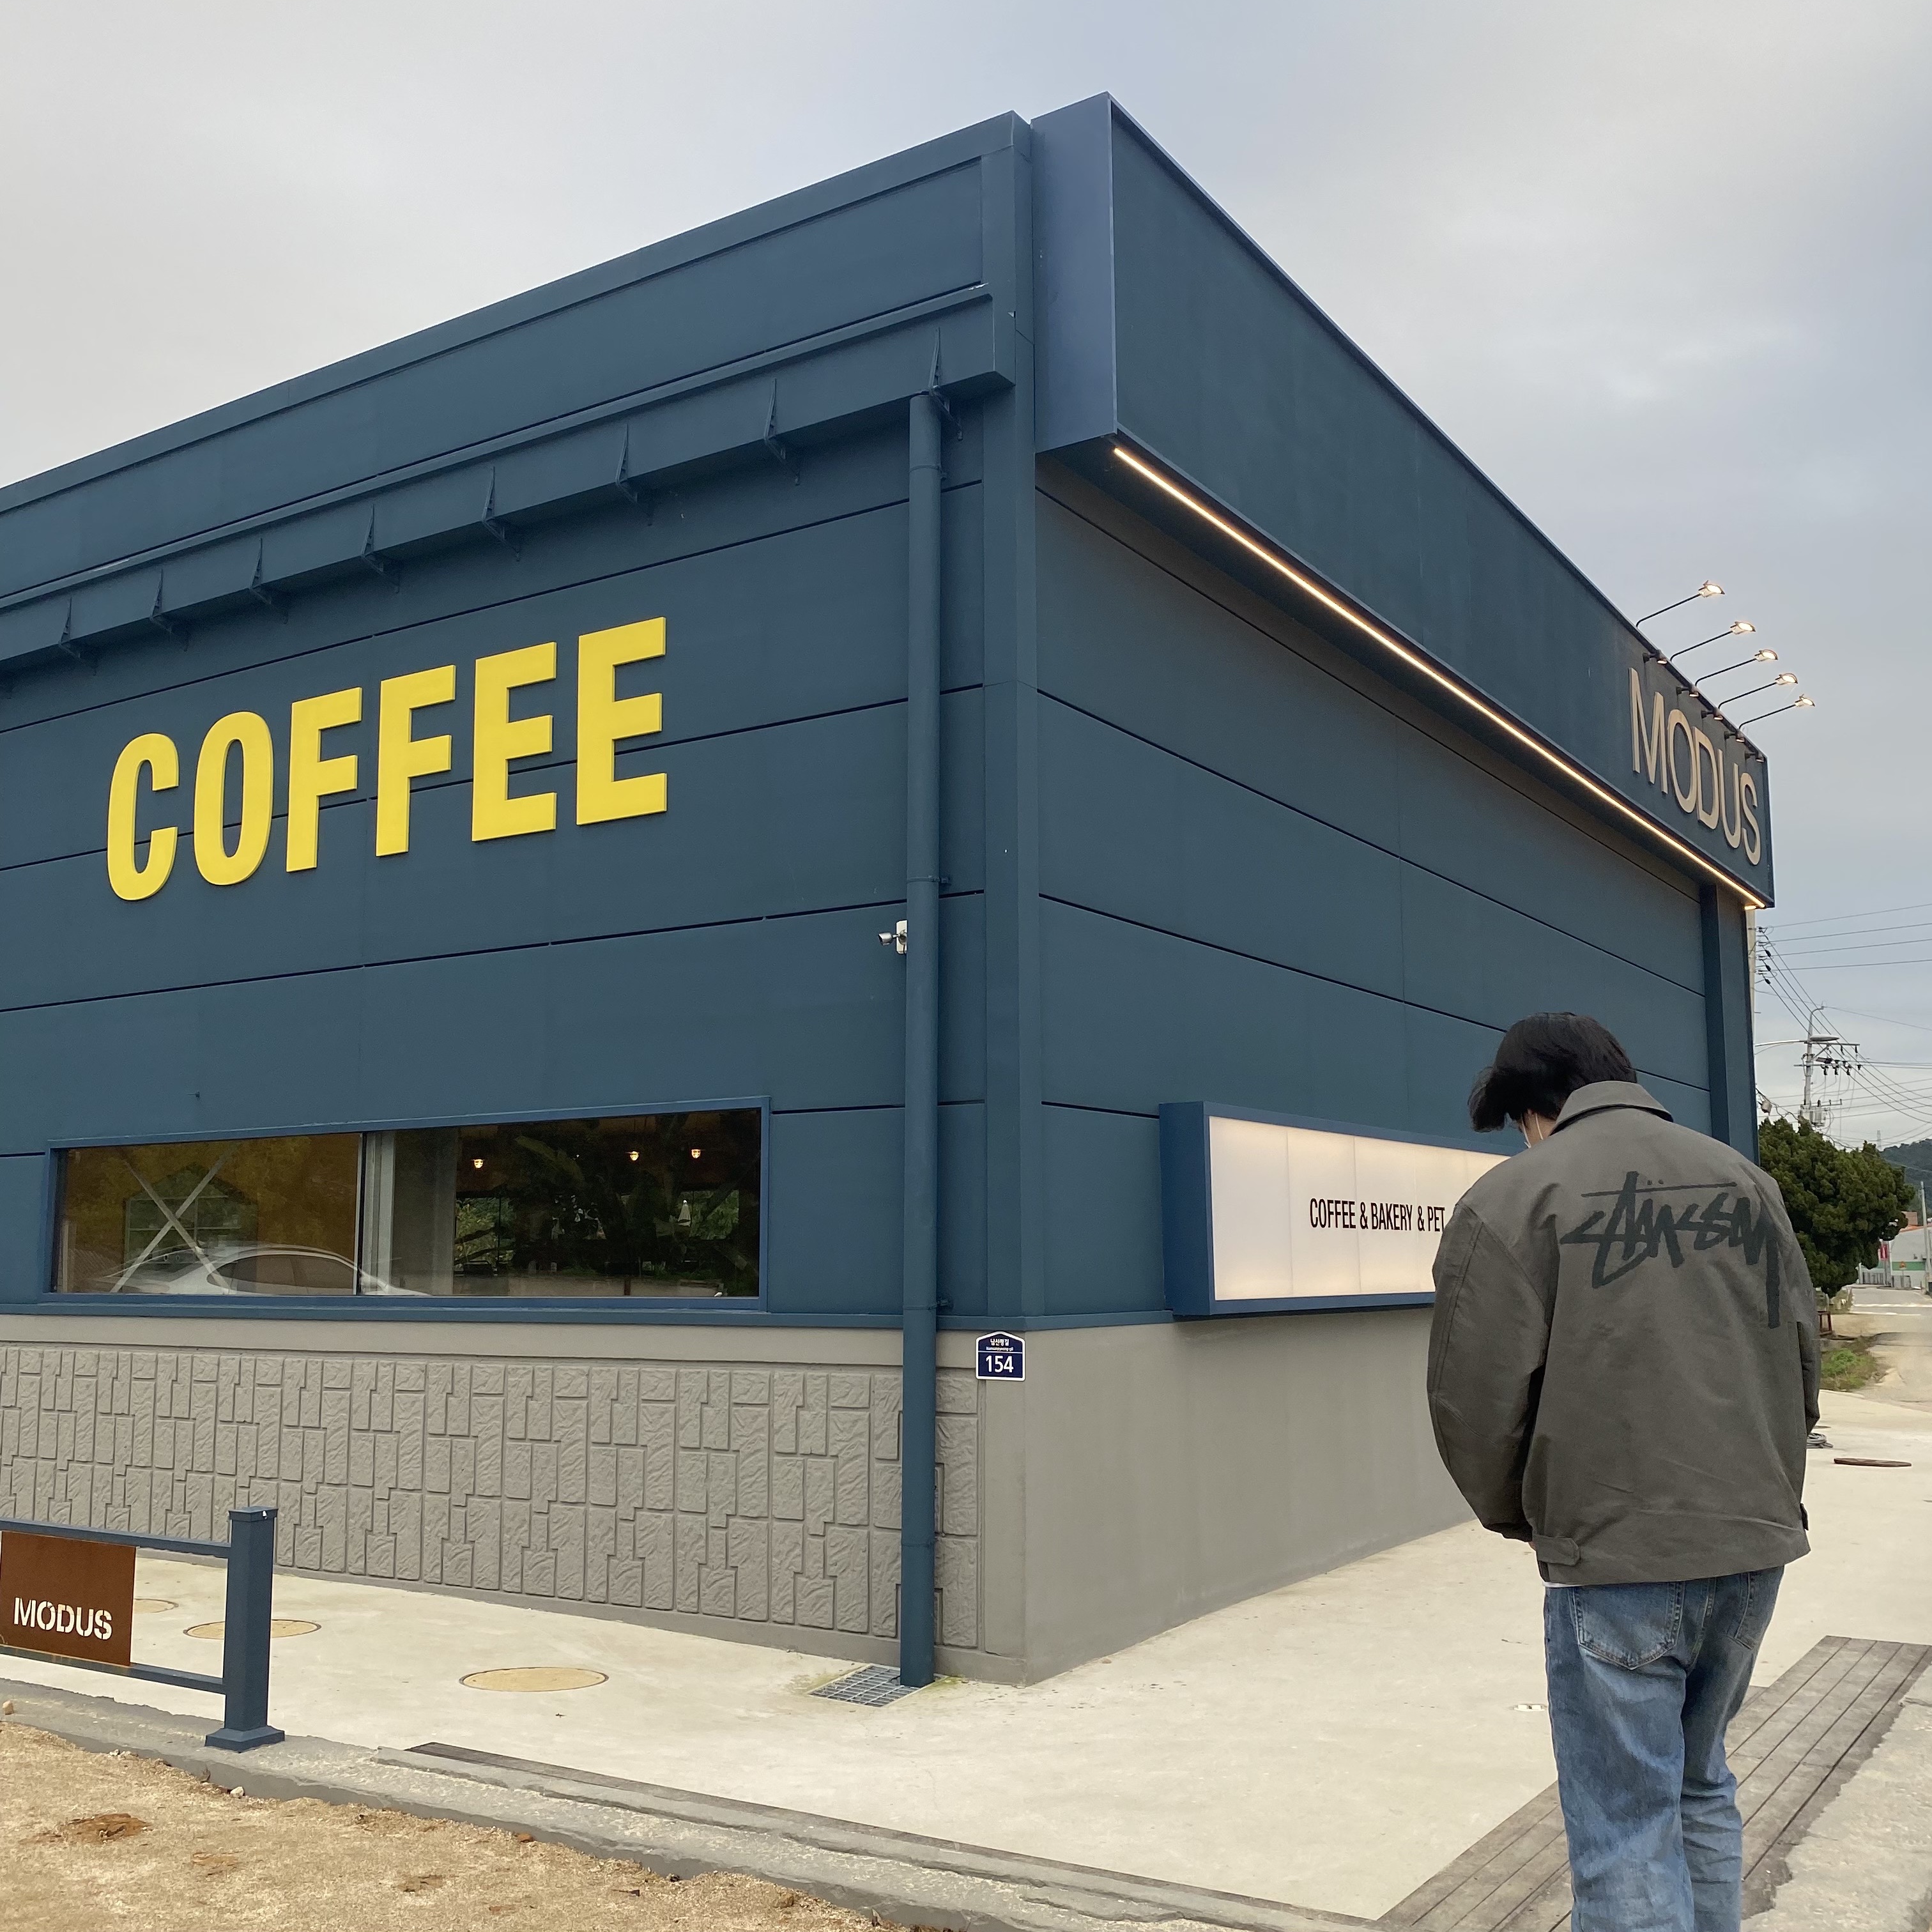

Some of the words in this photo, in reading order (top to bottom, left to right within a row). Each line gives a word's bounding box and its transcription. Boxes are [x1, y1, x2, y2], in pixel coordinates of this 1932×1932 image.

[106, 616, 668, 901] COFFEE
[1629, 667, 1761, 865] MODUS
[1310, 1197, 1356, 1229] COFFEE
[1360, 1201, 1368, 1230] &
[1370, 1202, 1413, 1231] BAKERY
[1417, 1205, 1425, 1232] &
[1427, 1206, 1445, 1232] PET
[986, 1355, 1014, 1373] 154
[13, 1597, 112, 1640] MODUS
